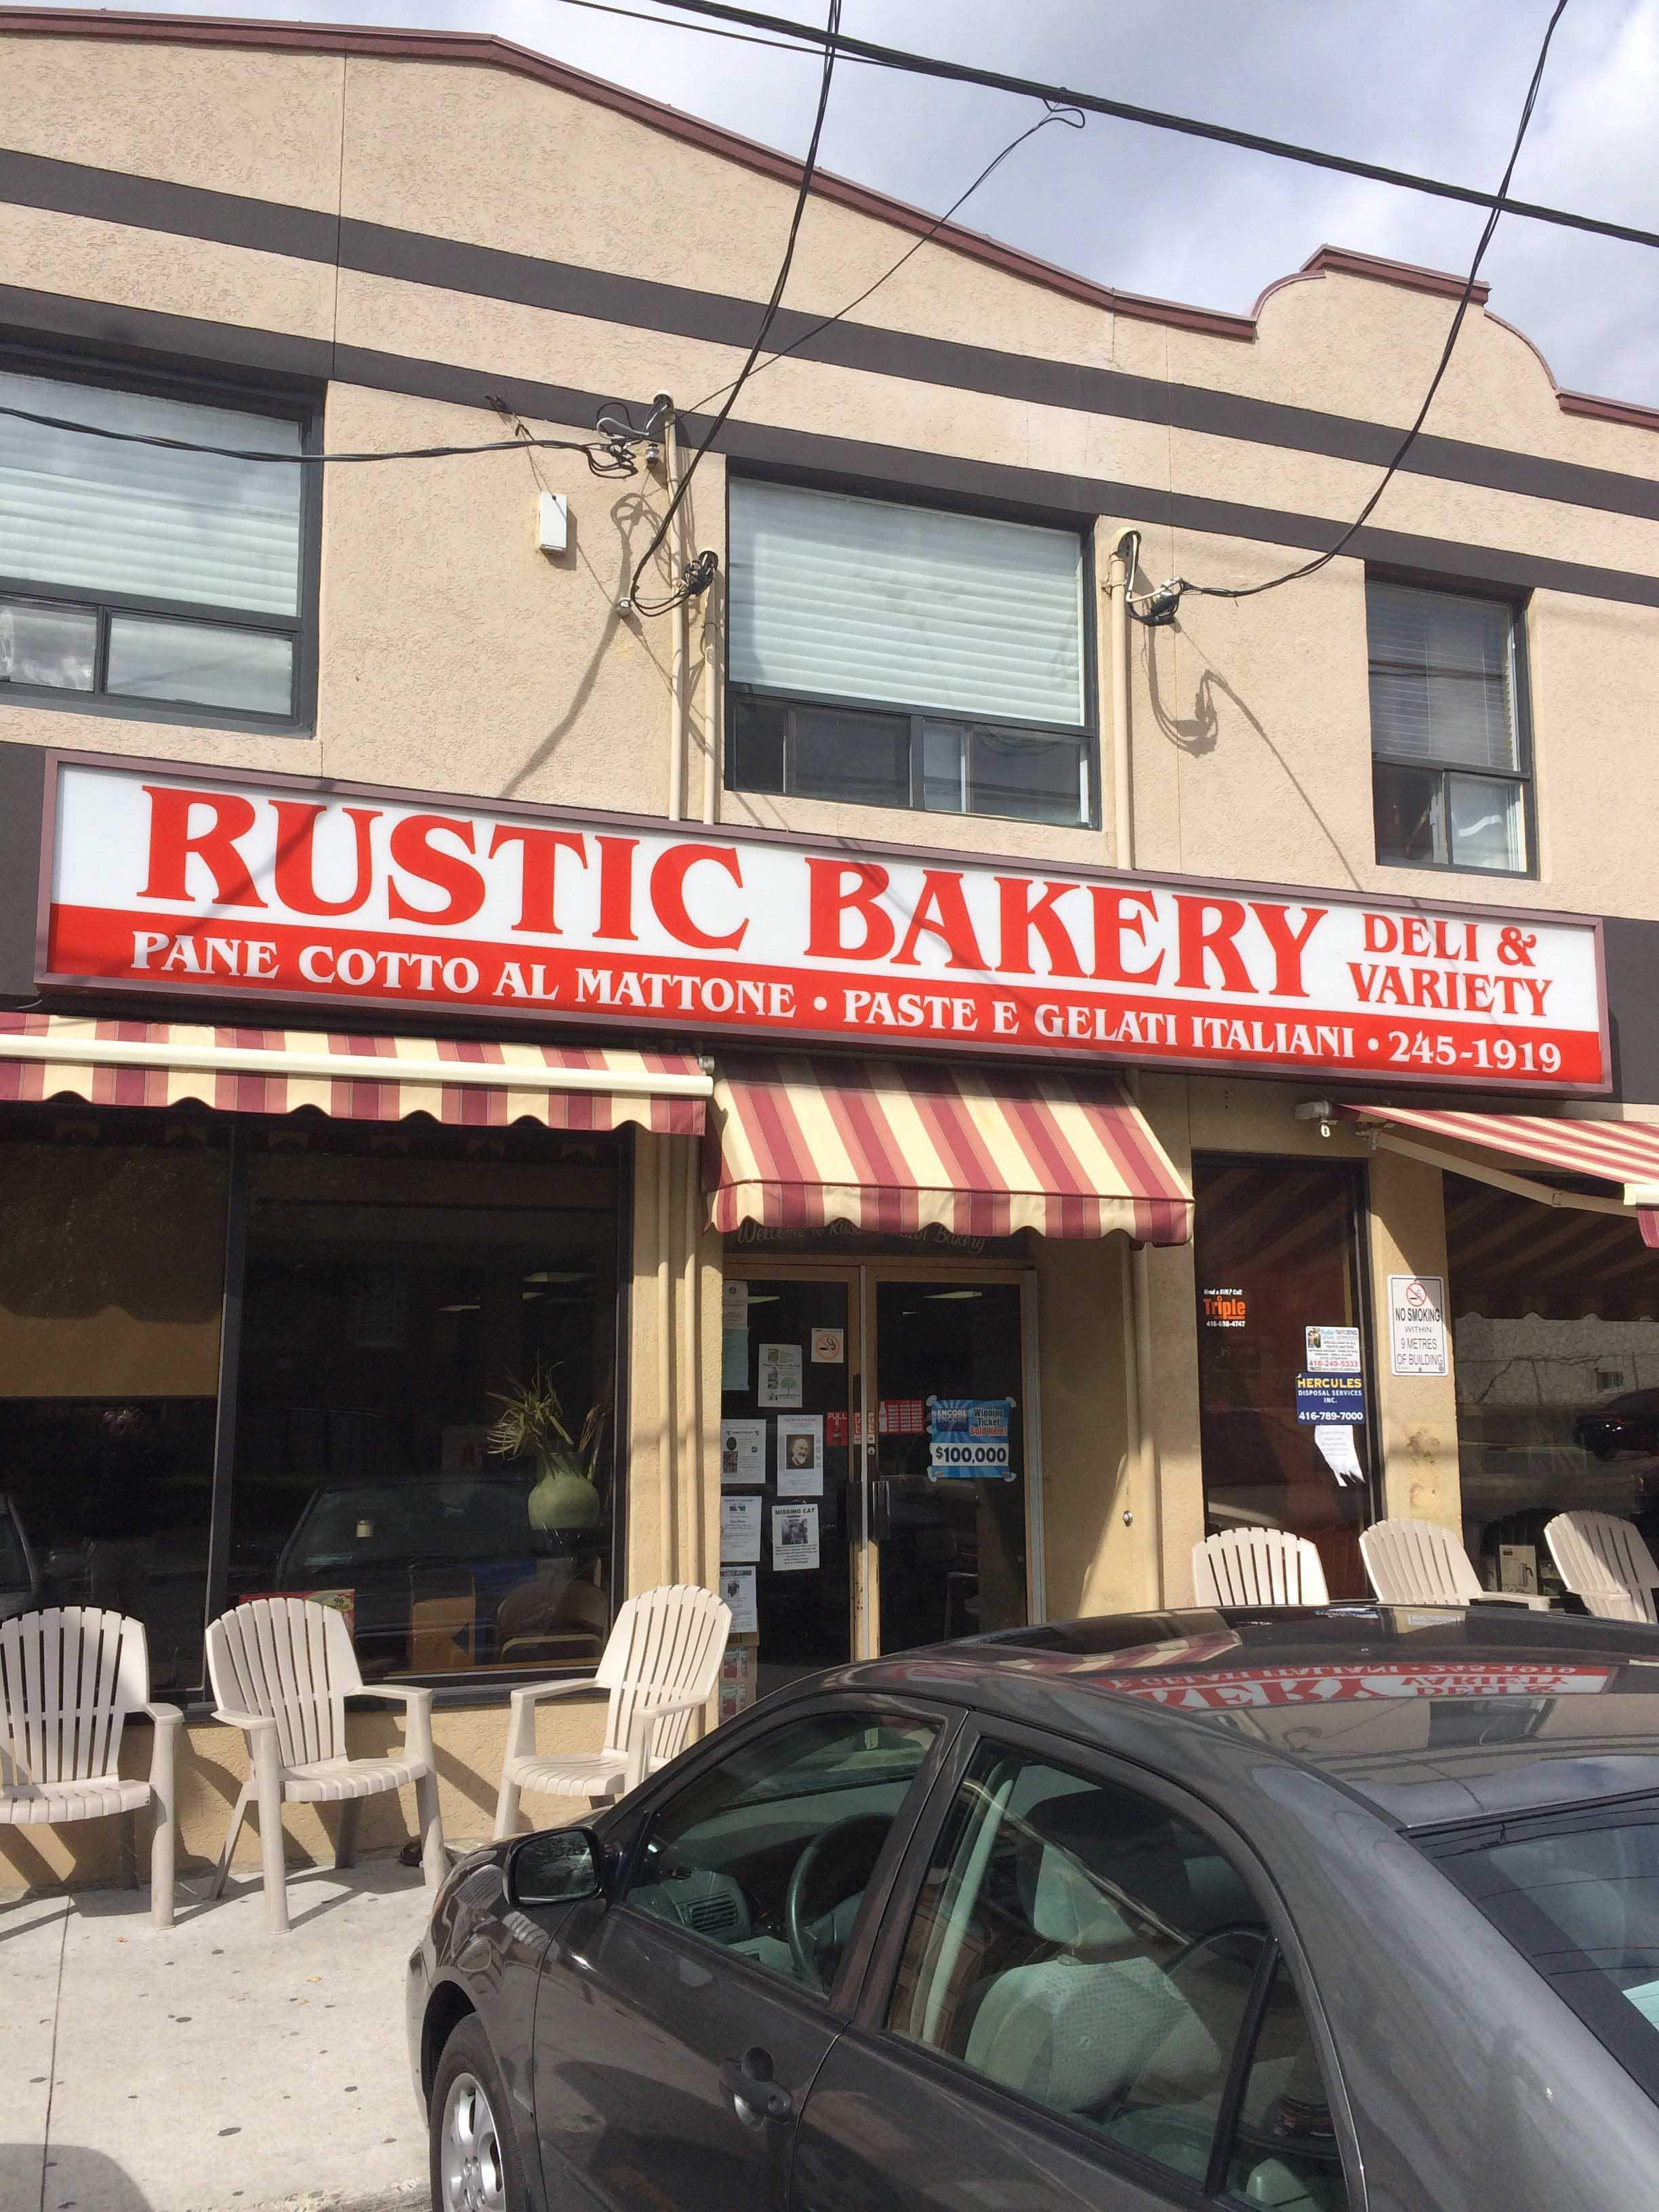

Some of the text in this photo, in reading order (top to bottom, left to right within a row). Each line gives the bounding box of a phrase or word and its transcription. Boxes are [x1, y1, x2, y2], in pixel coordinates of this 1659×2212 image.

[138, 785, 1328, 998] RUSTIC BAKERY
[1363, 913, 1537, 966] DELI &
[1348, 963, 1551, 1017] VARIETY
[131, 930, 1561, 1073] PANE COTTO AL MATTONE PASTE E GELATI ITALIANI 245-1919
[1203, 1295, 1246, 1319] Triple
[1395, 1307, 1441, 1322] NO SMOKING
[1401, 1338, 1437, 1350] 9 METRES
[1397, 1354, 1443, 1366] OF BUILDING
[1297, 1378, 1362, 1388] HERCULES
[827, 1412, 847, 1420] PULL
[973, 1408, 1004, 1418] Winning
[1298, 1412, 1364, 1420] 416-789-7000
[977, 1418, 1000, 1427] Ticket
[935, 1446, 1006, 1465] $100,000
[334, 1597, 344, 1605] 96
